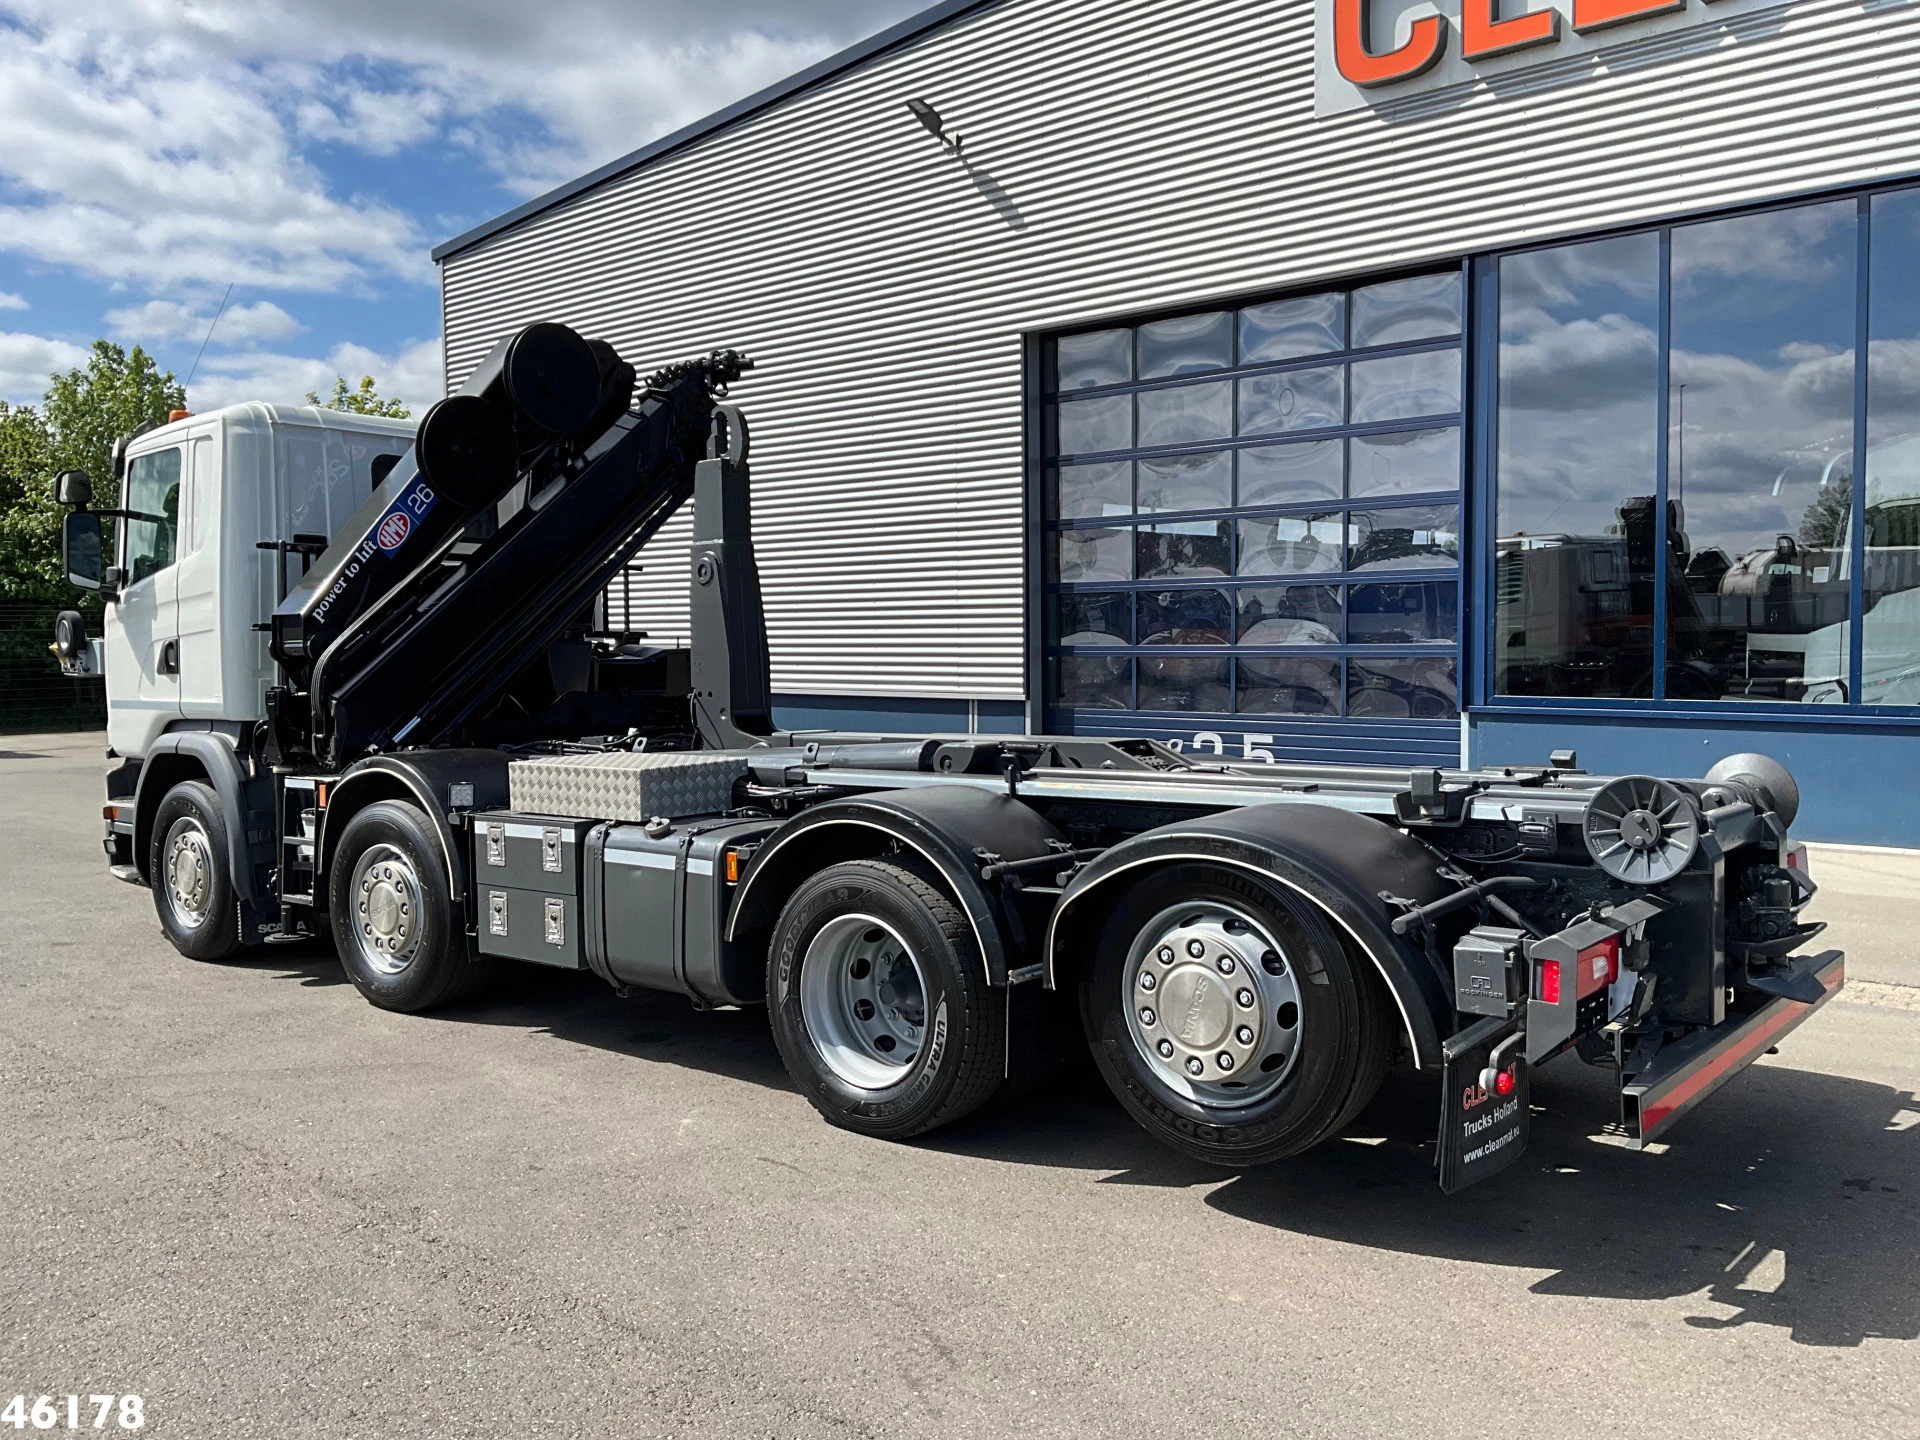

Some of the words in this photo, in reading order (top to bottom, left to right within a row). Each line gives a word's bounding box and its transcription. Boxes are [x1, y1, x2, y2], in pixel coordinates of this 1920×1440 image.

[406, 483, 435, 515] 26
[378, 513, 408, 548] HMF
[312, 576, 348, 624] power
[344, 563, 360, 578] to
[356, 539, 378, 564] lift
[257, 920, 307, 934] SCAA
[1473, 959, 1487, 967] TOP
[1180, 975, 1209, 1039] SCANIA
[1459, 987, 1505, 999] ROCKINGER
[927, 1020, 946, 1073] ULTRA
[1462, 1062, 1517, 1110] CLET
[1463, 1114, 1493, 1137] Trucks
[1493, 1095, 1518, 1123] Holland
